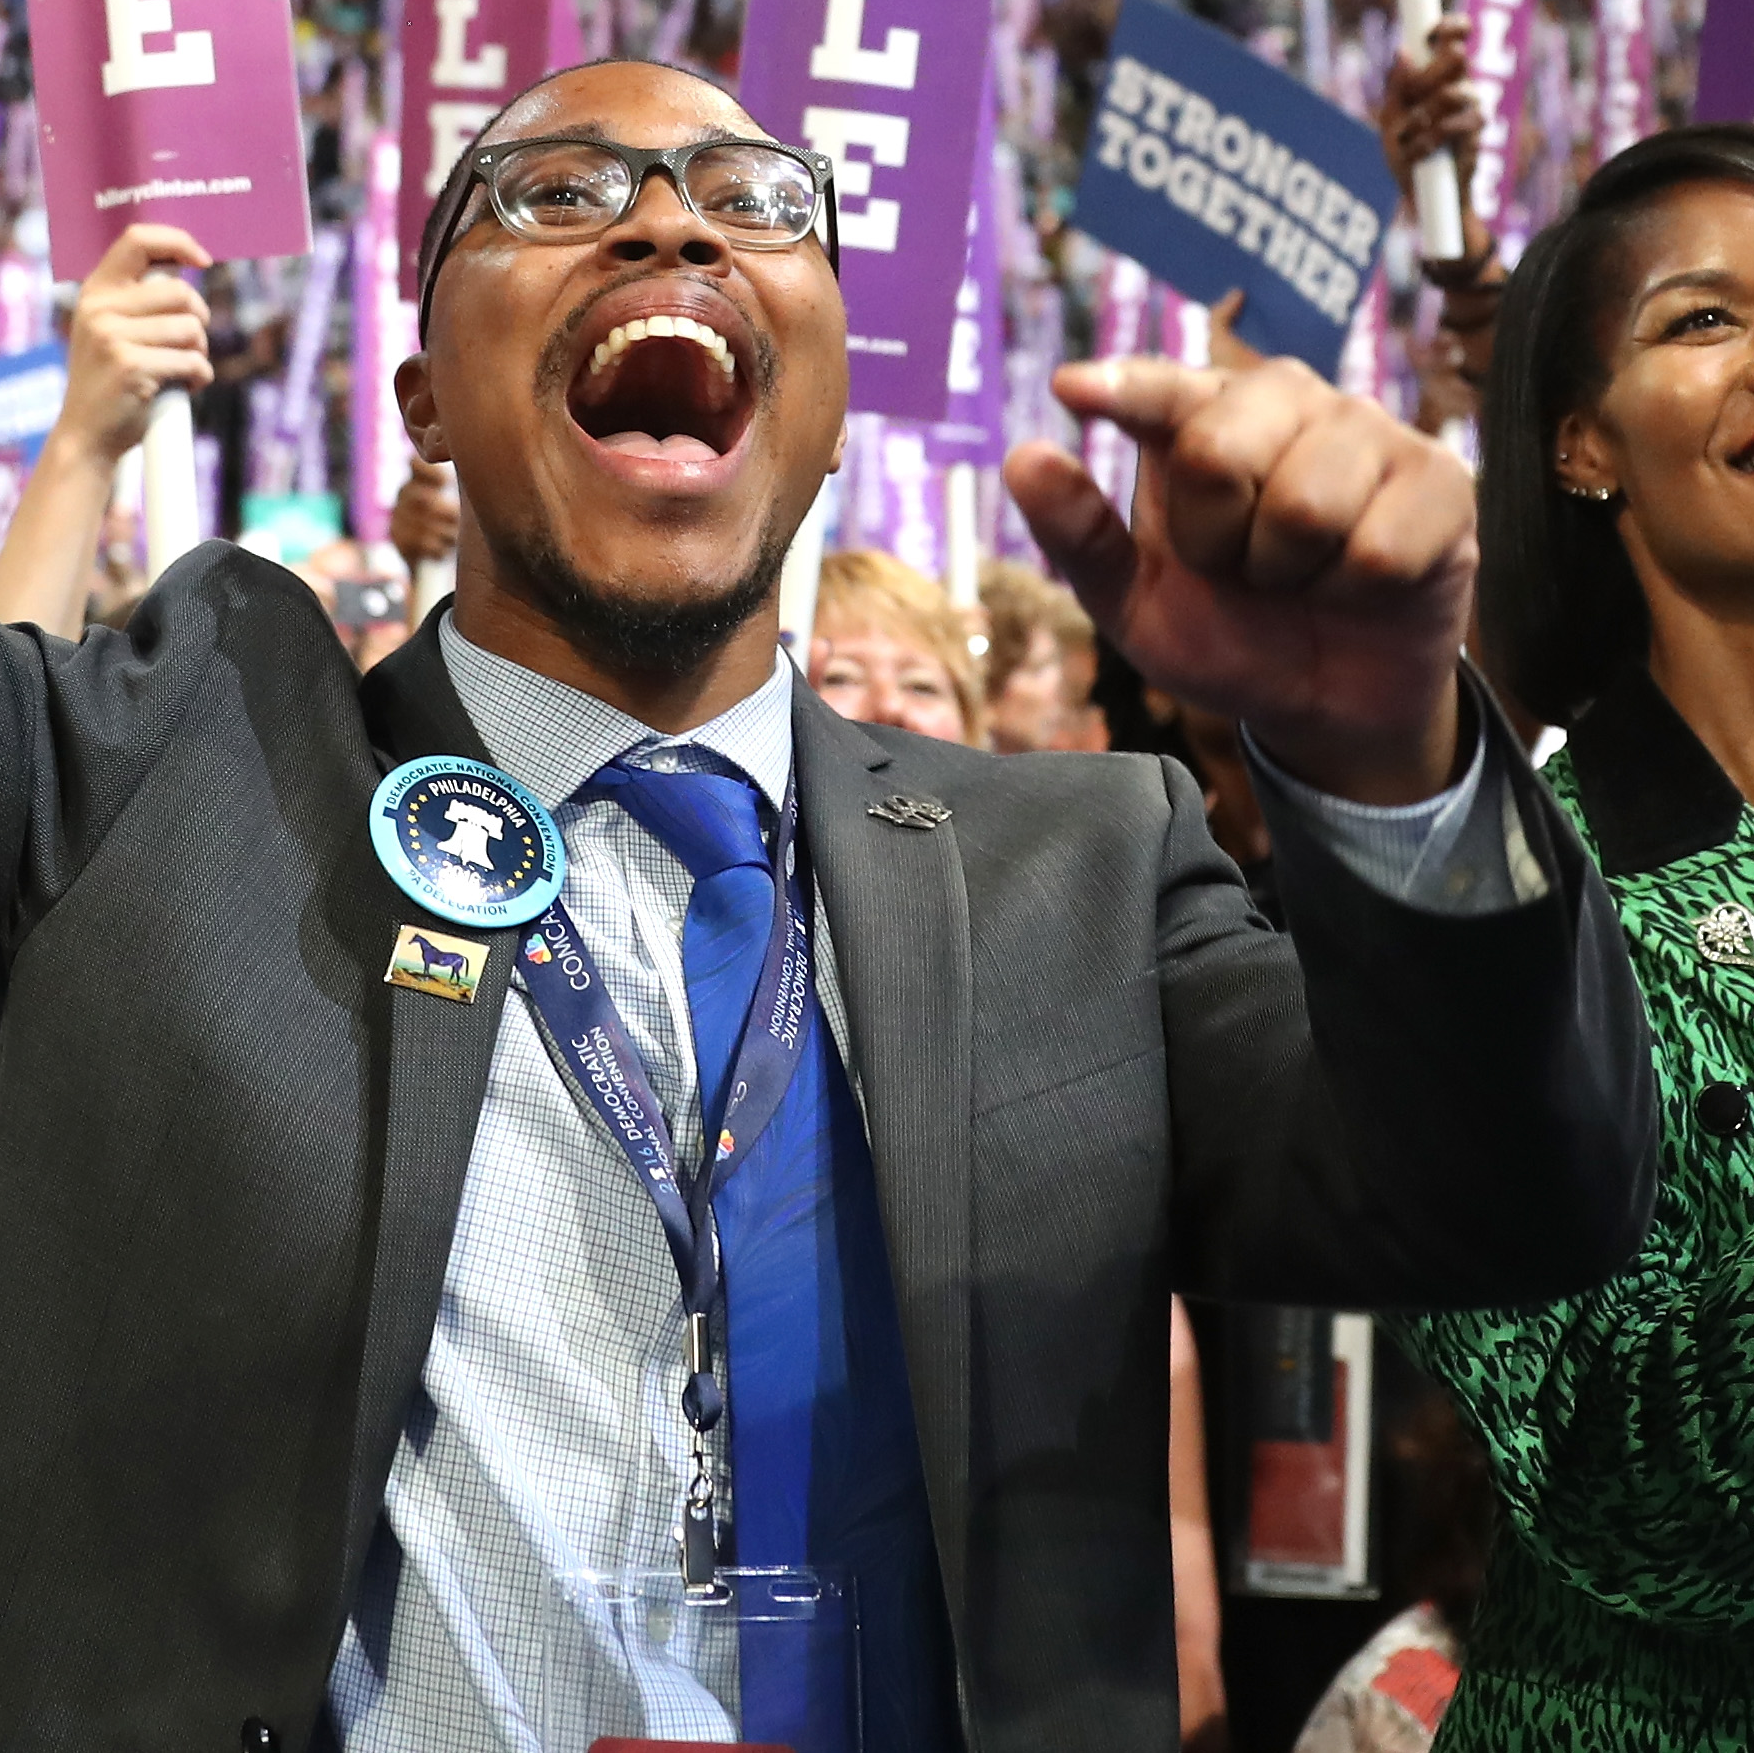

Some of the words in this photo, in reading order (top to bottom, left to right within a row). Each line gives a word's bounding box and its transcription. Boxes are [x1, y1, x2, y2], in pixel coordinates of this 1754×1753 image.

[1105, 54, 1381, 267] STRONGER
[1097, 112, 1362, 325] TOGETHER
[386, 761, 454, 806] DEMOCRATIC
[456, 762, 521, 797] NATIONAL
[519, 795, 557, 871] CONVENTION
[427, 779, 528, 829] PHILADELPHIA
[407, 869, 422, 886] PA
[540, 902, 592, 991] COMCA
[768, 956, 794, 1039] CONVENTION
[781, 949, 809, 1049] DEMOCRATIC
[571, 1034, 643, 1142] DEMOCRATIC
[589, 1026, 645, 1121] CONVENTION
